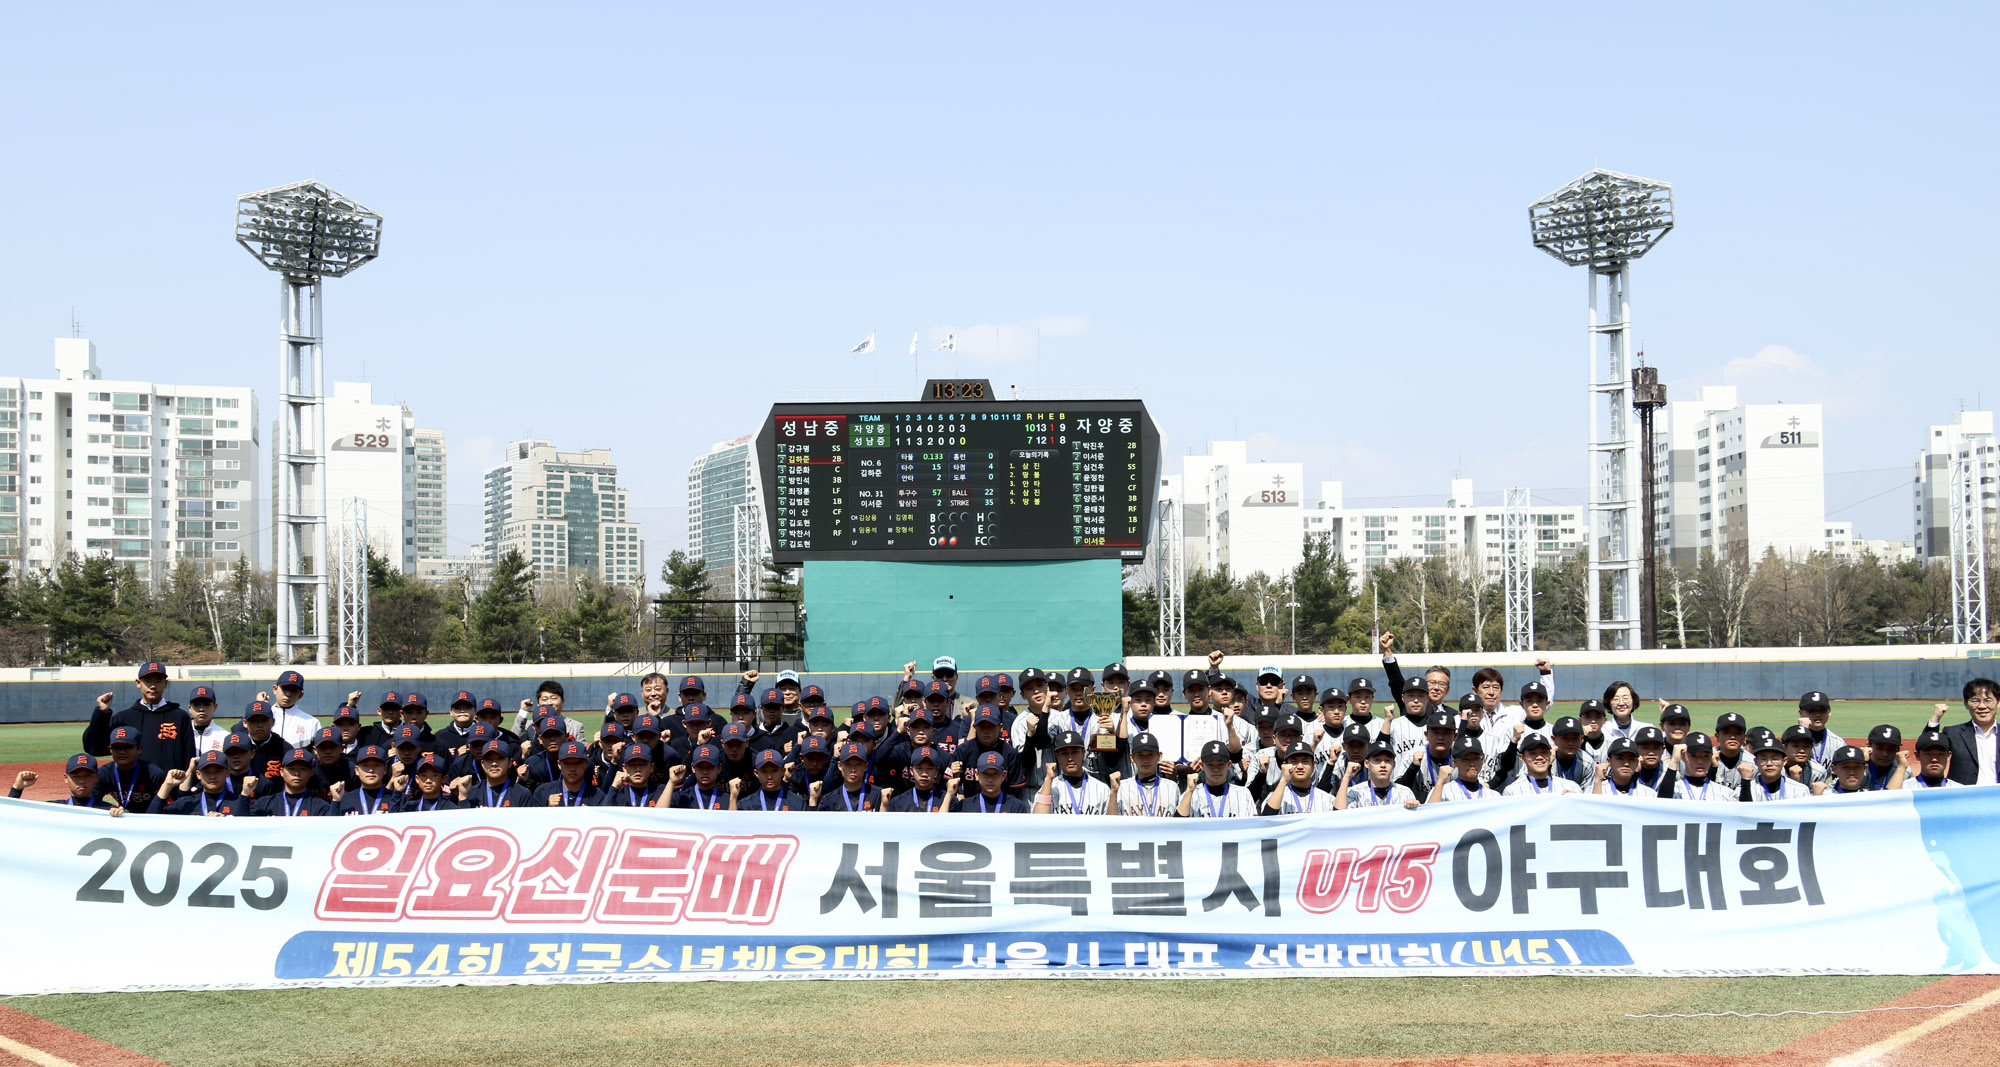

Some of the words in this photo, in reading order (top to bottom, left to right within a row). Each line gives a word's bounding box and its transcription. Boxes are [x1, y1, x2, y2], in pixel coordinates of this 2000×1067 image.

[935, 382, 984, 398] 13:23
[782, 420, 838, 436] 성남중
[1077, 418, 1133, 433] 자양중
[354, 434, 389, 448] 529
[1780, 432, 1801, 444] 511
[1262, 490, 1286, 503] 513
[930, 514, 936, 522] B
[977, 513, 984, 521] H
[930, 525, 935, 534] S
[978, 525, 983, 533] E
[929, 537, 937, 546] O
[975, 537, 987, 545] FC
[76, 838, 294, 912] 2025
[314, 825, 800, 926] 일요신문배
[820, 838, 1282, 918] 서울특별시
[1296, 841, 1440, 914] U15
[1452, 822, 1825, 915] 야구대회
[324, 942, 504, 978] 제54회
